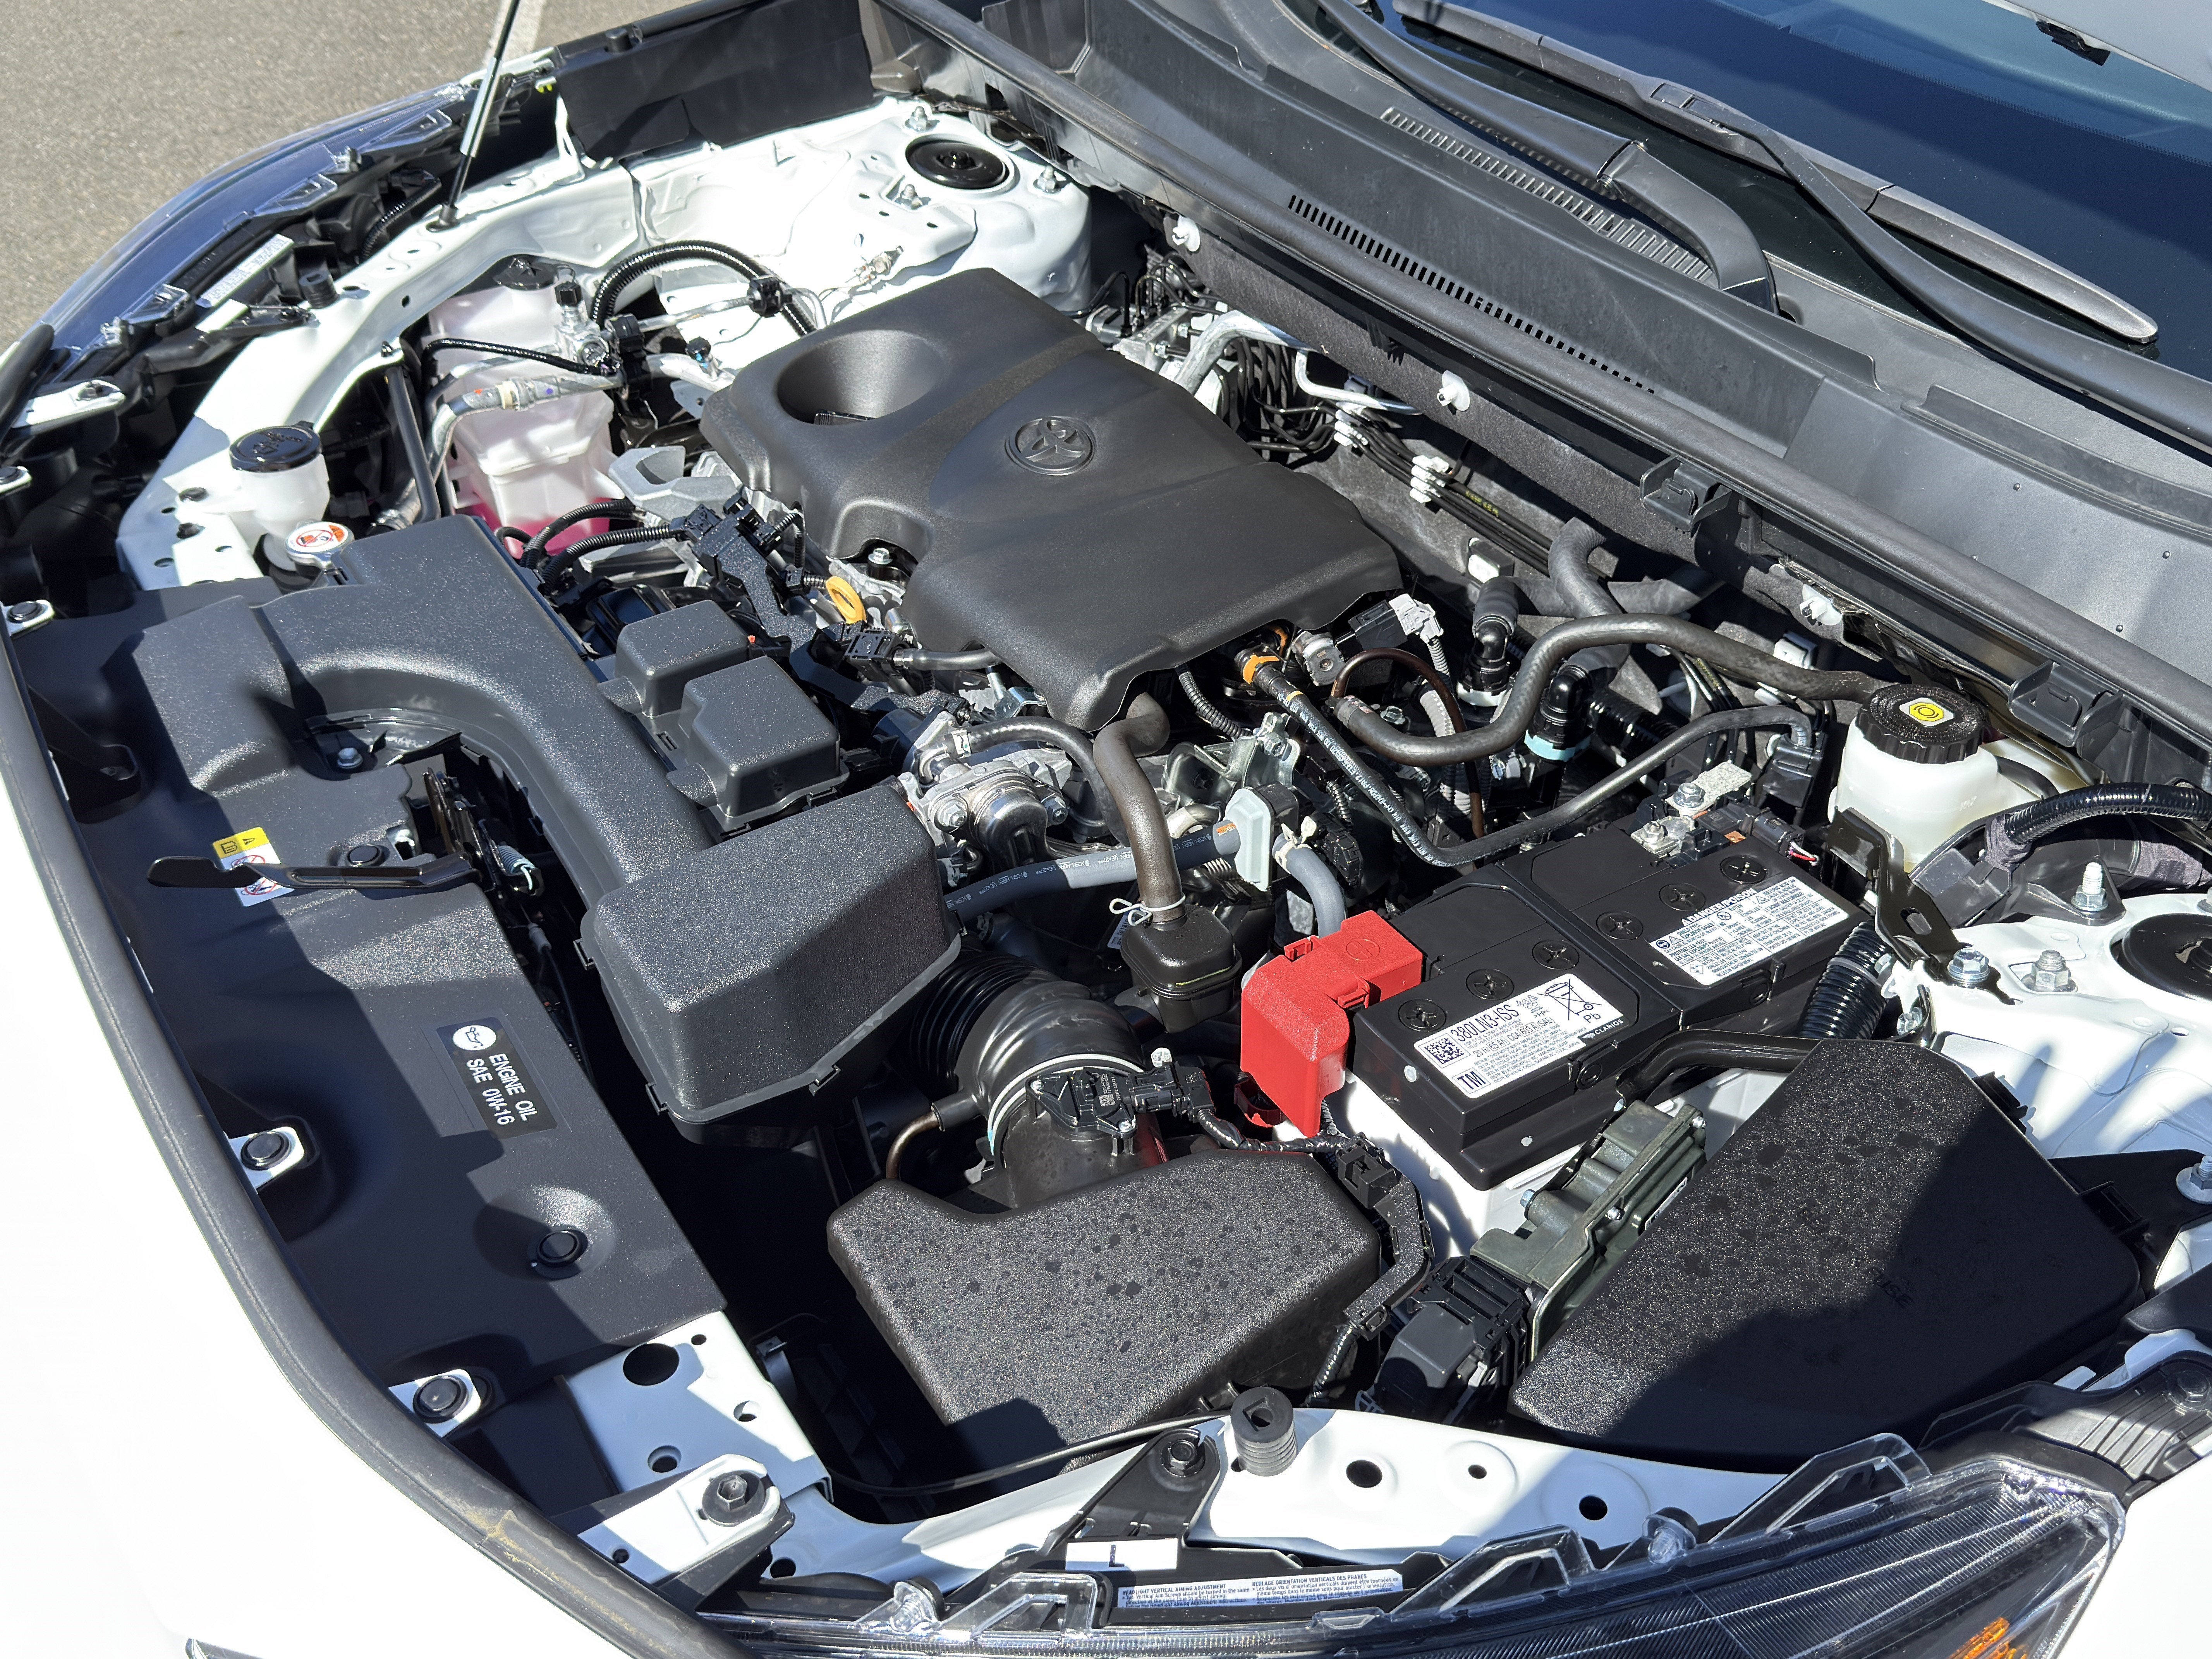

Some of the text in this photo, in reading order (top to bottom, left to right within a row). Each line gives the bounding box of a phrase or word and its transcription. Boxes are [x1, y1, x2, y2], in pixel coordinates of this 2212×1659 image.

[1686, 887, 1757, 922] DANGER/POISON
[1448, 1003, 1521, 1042] 380LN3-ISS
[1582, 1011, 1602, 1023] Pb
[1593, 1018, 1625, 1035] CLARIOS
[1472, 1049, 1484, 1058] 20
[1480, 1045, 1492, 1054] Hr
[1487, 1041, 1500, 1050] 65
[1496, 1037, 1508, 1046] Ah
[1506, 1031, 1523, 1041] CCA
[1535, 1016, 1556, 1029] (SAE)
[467, 1058, 515, 1125] SAE 0W-16
[489, 1053, 538, 1121] ENGINE OIL
[1457, 1071, 1486, 1089] TM
[1109, 1544, 1125, 1567] L
